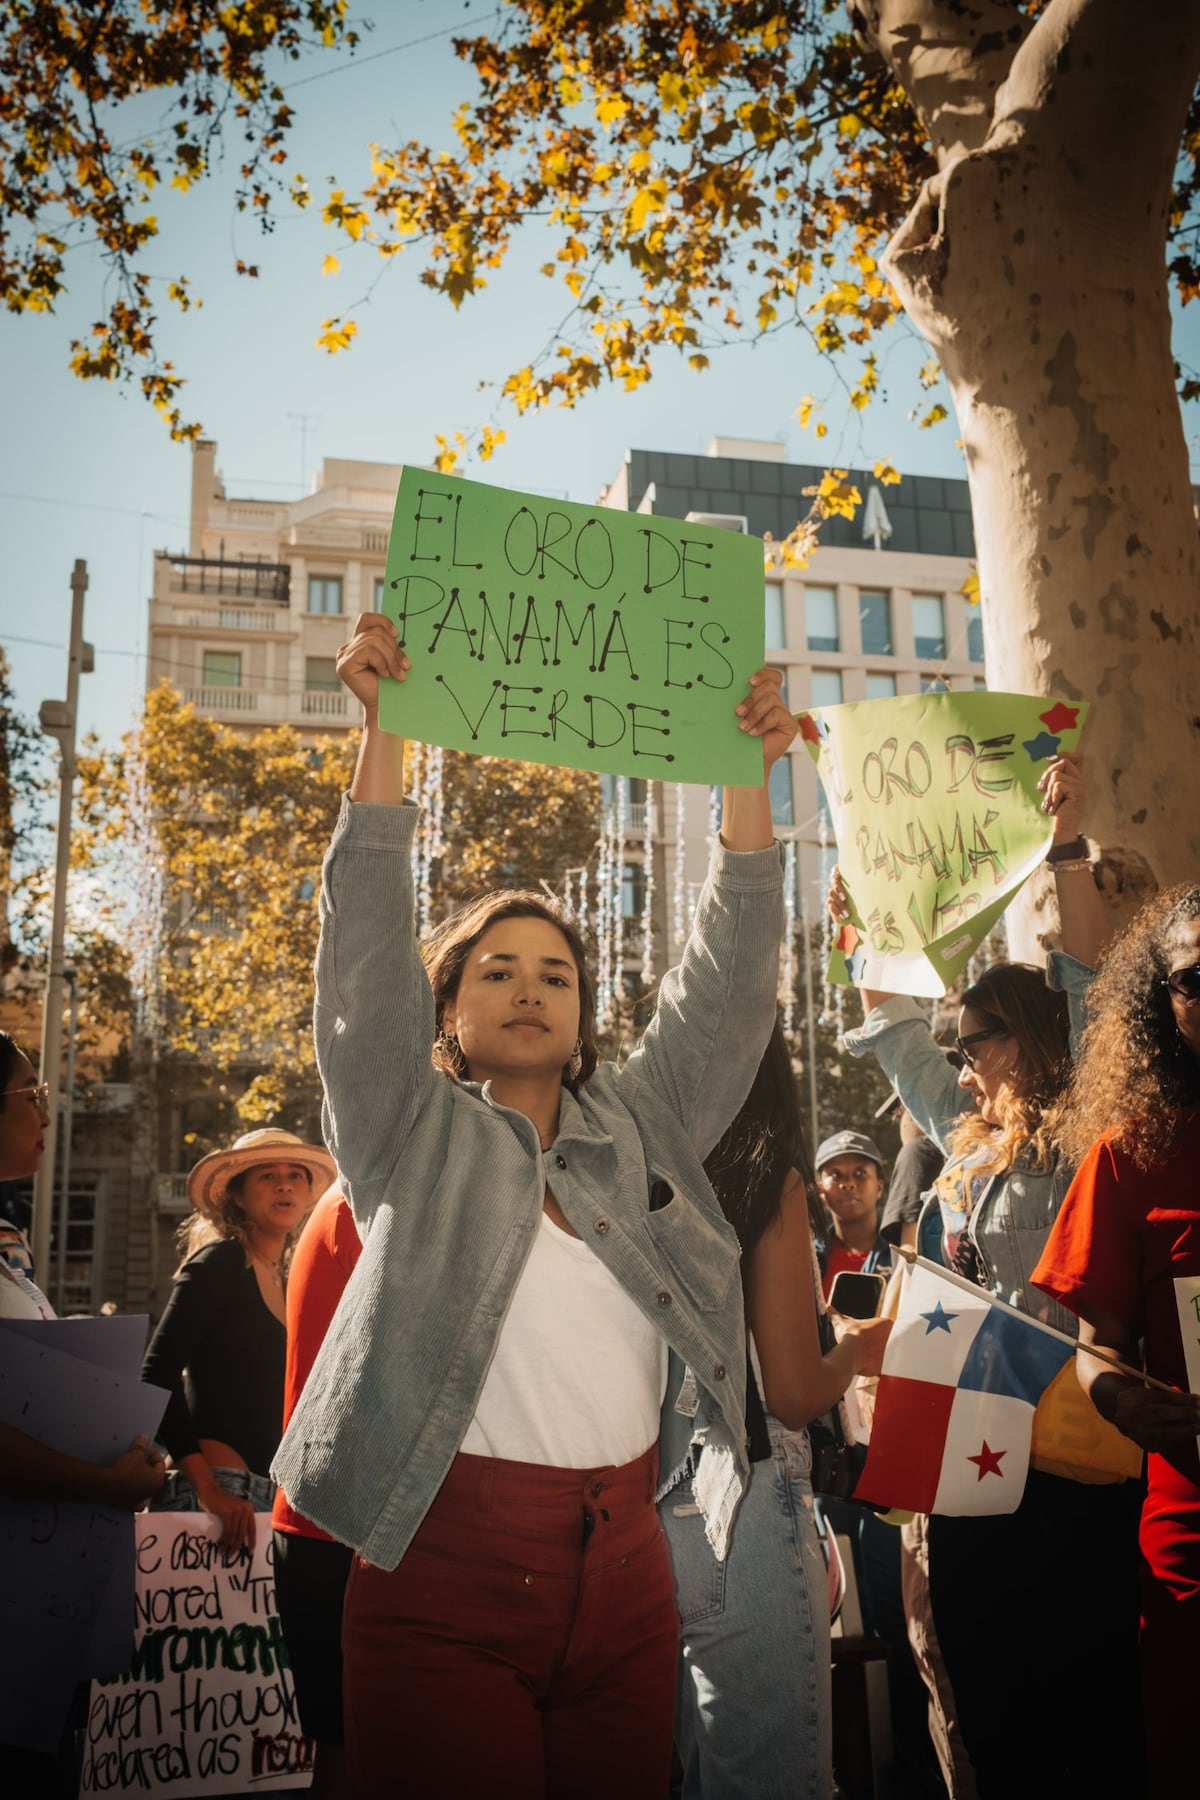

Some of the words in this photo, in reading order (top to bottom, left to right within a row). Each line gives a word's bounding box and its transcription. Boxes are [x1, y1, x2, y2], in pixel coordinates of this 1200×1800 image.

[410, 488, 483, 570] EL
[504, 506, 614, 590] ORO
[636, 528, 714, 603] DE
[390, 574, 639, 680] PANAMÁ
[662, 618, 734, 689] ES
[435, 674, 675, 762] VERDE
[861, 736, 932, 806] ORO
[944, 732, 1017, 800] DE
[855, 808, 1008, 887] PANAMÁ
[866, 906, 905, 957] ES
[88, 1688, 162, 1744] even
[82, 1732, 192, 1792] declared
[198, 1733, 242, 1780] as
